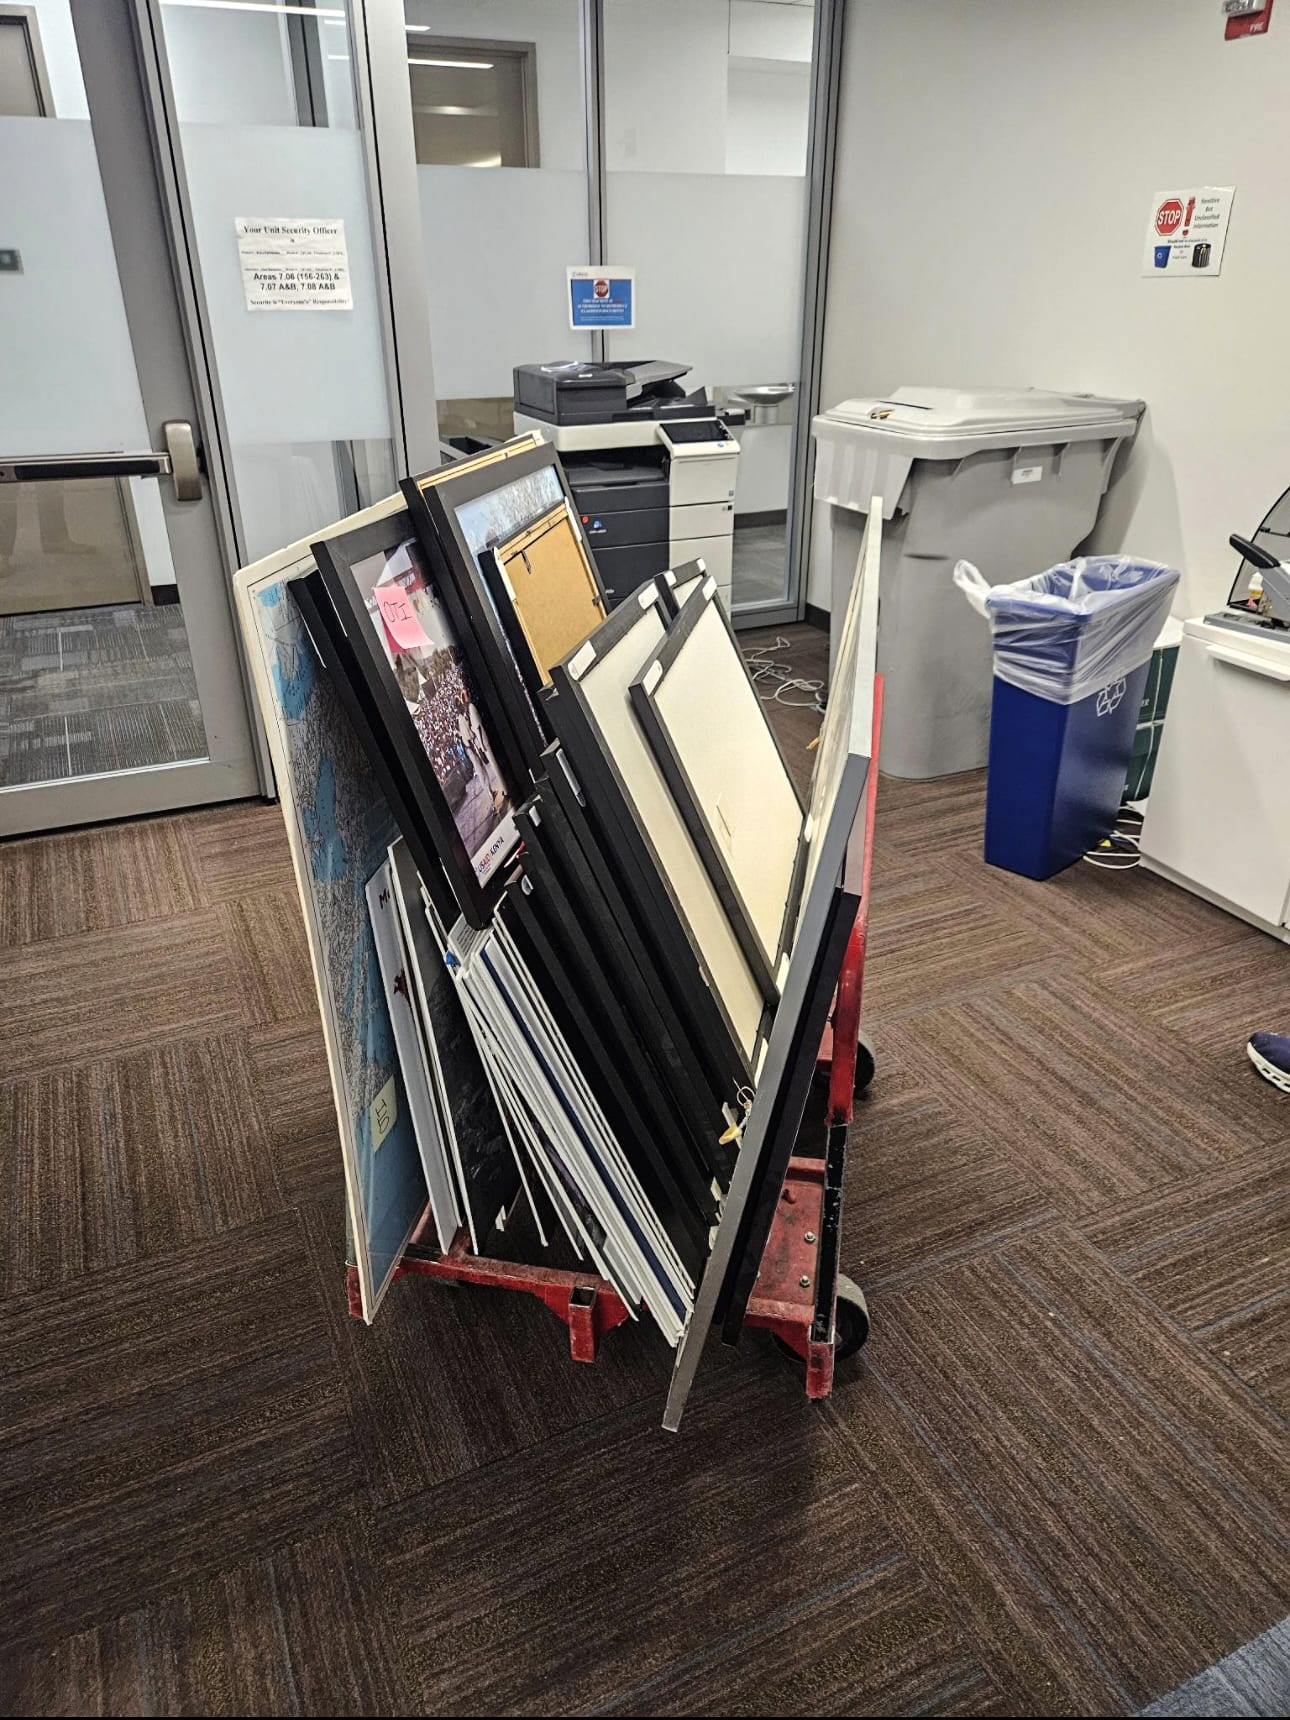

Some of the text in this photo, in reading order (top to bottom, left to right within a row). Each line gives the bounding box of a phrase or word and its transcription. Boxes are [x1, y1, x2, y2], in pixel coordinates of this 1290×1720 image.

[1158, 209, 1180, 225] STOP
[243, 226, 338, 236] Your Unit Security Officer
[253, 272, 277, 281] Areas
[334, 272, 340, 280] &
[260, 282, 276, 291] 7.07
[318, 282, 336, 290] A&B
[383, 600, 413, 622] OTI
[478, 853, 491, 873] USAID
[490, 836, 505, 856] KENYA
